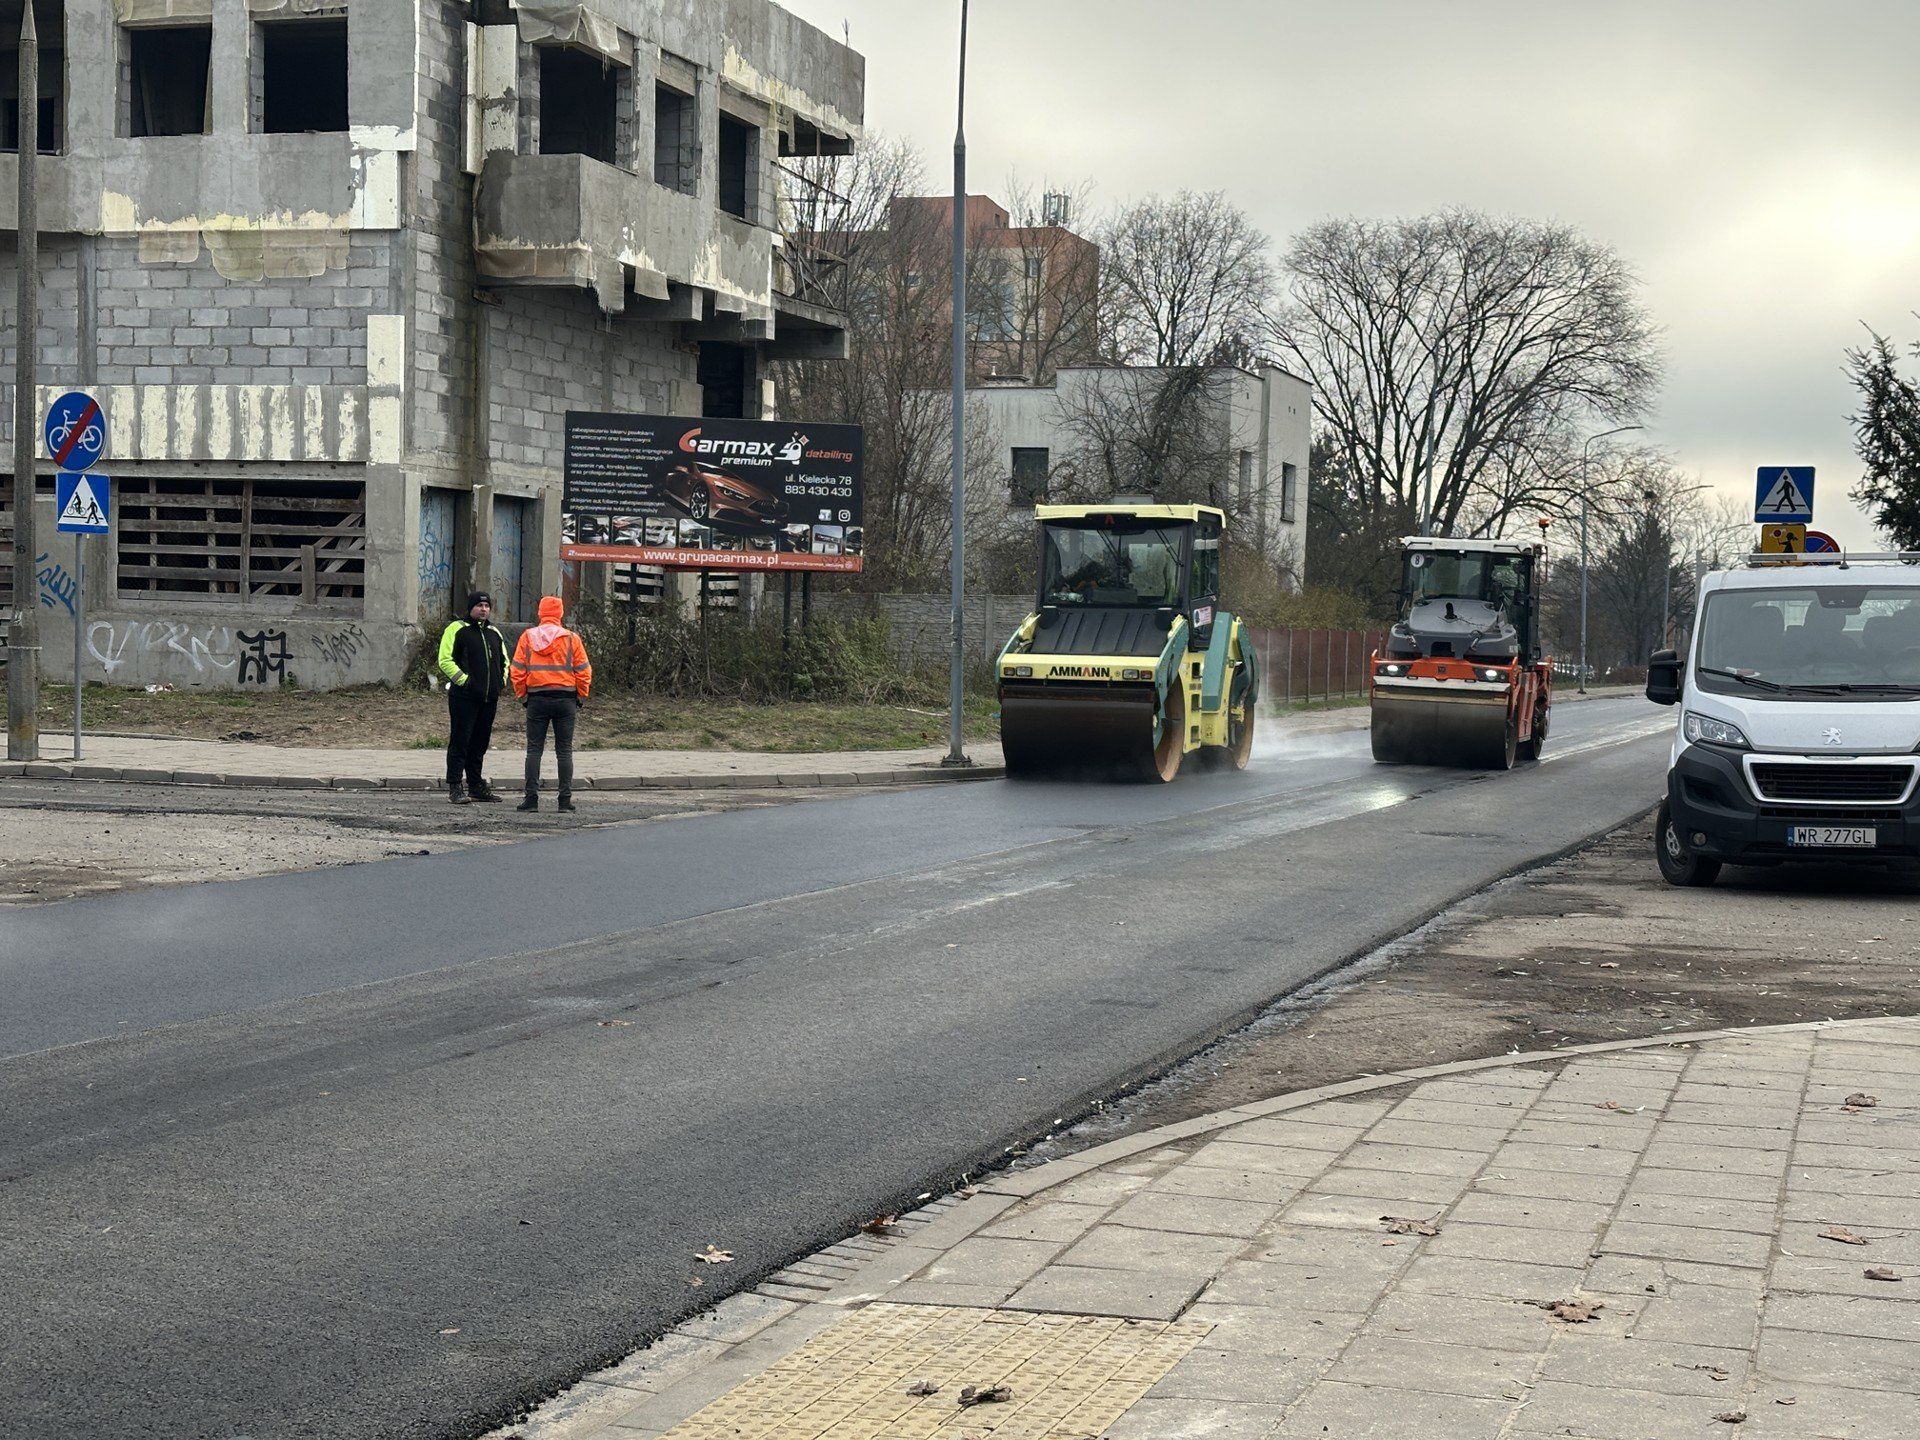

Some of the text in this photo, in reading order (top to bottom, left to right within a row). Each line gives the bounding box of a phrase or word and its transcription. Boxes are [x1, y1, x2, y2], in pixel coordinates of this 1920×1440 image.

[679, 427, 776, 456] Carmax
[720, 456, 772, 467] premium
[805, 450, 853, 462] detailing
[785, 474, 796, 482] ul.
[799, 474, 836, 484] Kielecka
[785, 485, 852, 497] 883 430 430
[643, 549, 779, 566] www.grupacarmax.pl
[1049, 666, 1110, 677] AMMANN
[1798, 828, 1871, 844] WR 277GL
